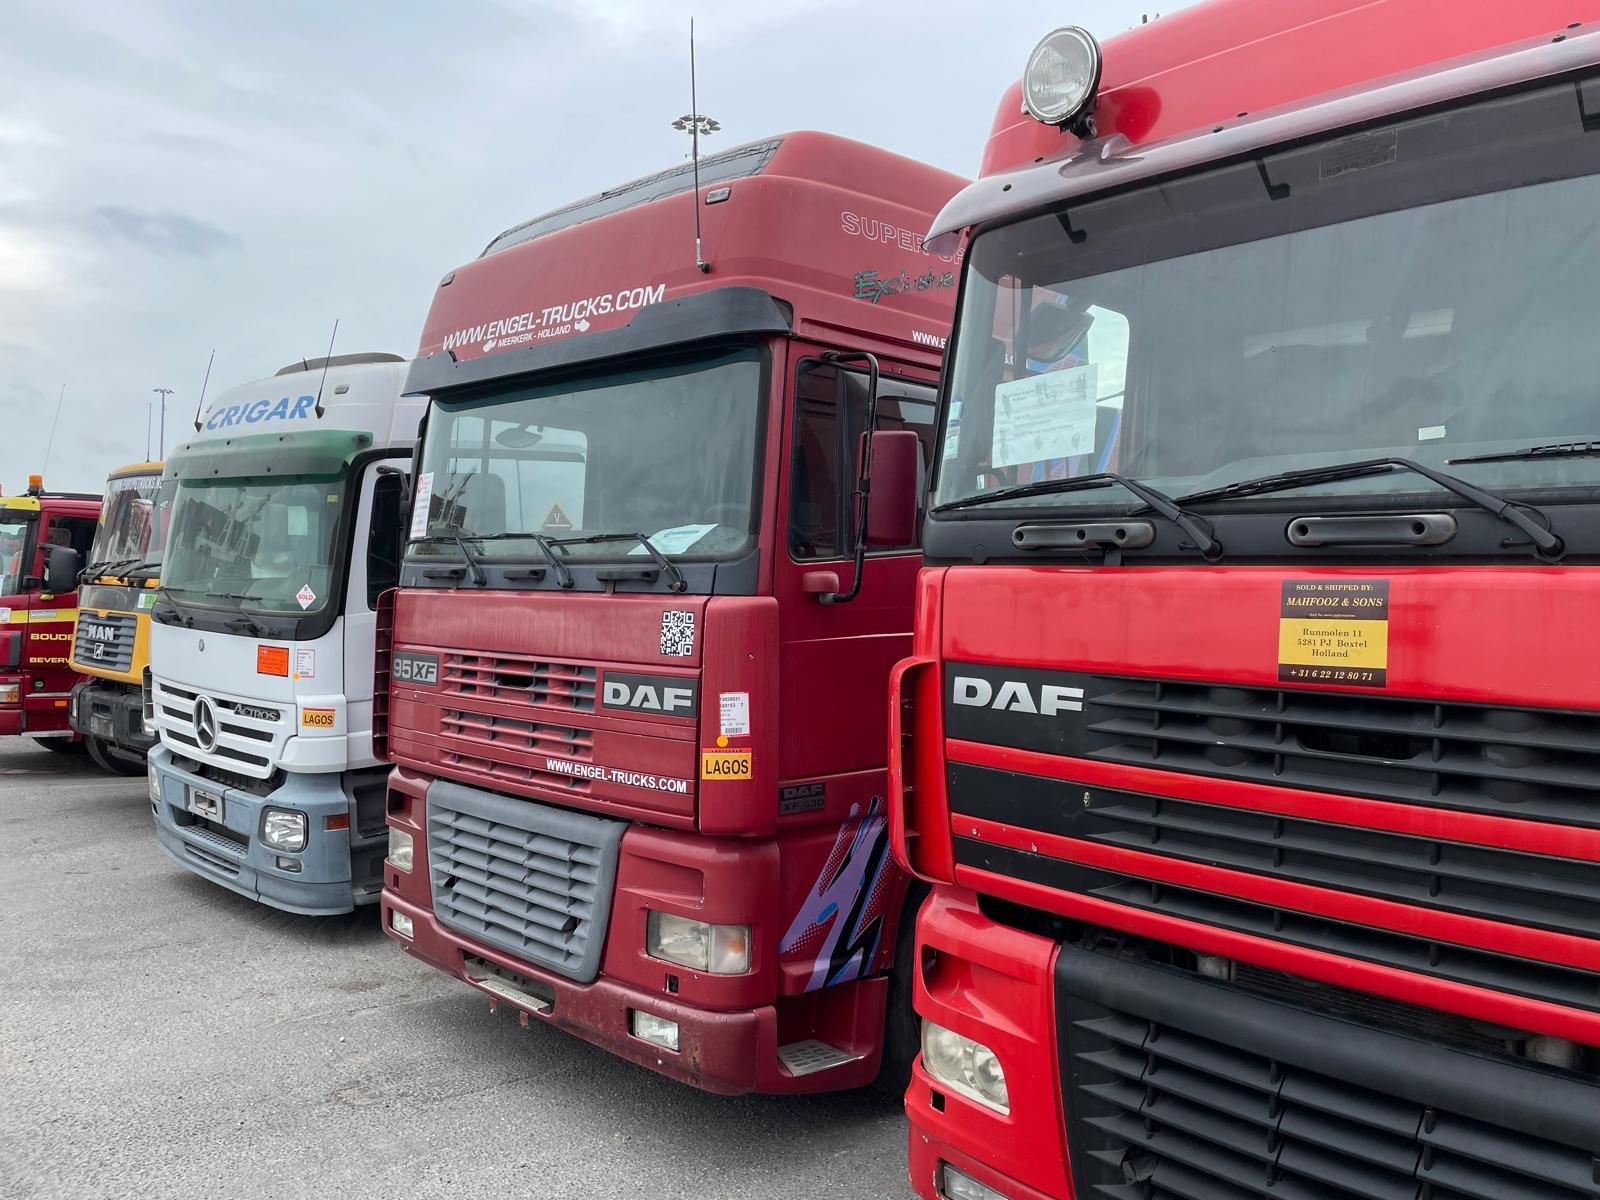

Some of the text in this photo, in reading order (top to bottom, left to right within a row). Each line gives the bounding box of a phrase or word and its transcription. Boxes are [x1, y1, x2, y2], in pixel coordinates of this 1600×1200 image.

[442, 283, 666, 351] WWW.ENGEL-TRUCKS.COM
[498, 334, 533, 348] MEERKERK
[537, 324, 571, 339] HOLLAND
[206, 395, 315, 430] CRIGAR
[1286, 597, 1383, 607] MAHFOOZ & SONS
[87, 624, 115, 640] MAN
[1302, 628, 1349, 637] Runmolen
[1297, 638, 1367, 648] 5281 PJ Boxtel
[1312, 649, 1349, 658] Holland
[1311, 669, 1318, 678] 6
[1319, 670, 1331, 678] 22
[1334, 671, 1346, 679] 12
[1347, 671, 1359, 680] 80
[1362, 672, 1373, 681] 71
[603, 681, 693, 711] DAF
[953, 675, 1084, 716] DAF
[304, 714, 333, 725] LAGOS
[705, 759, 749, 775] LAGOS
[546, 758, 687, 793] WWW.ENGEL-TRUCKS.COM
